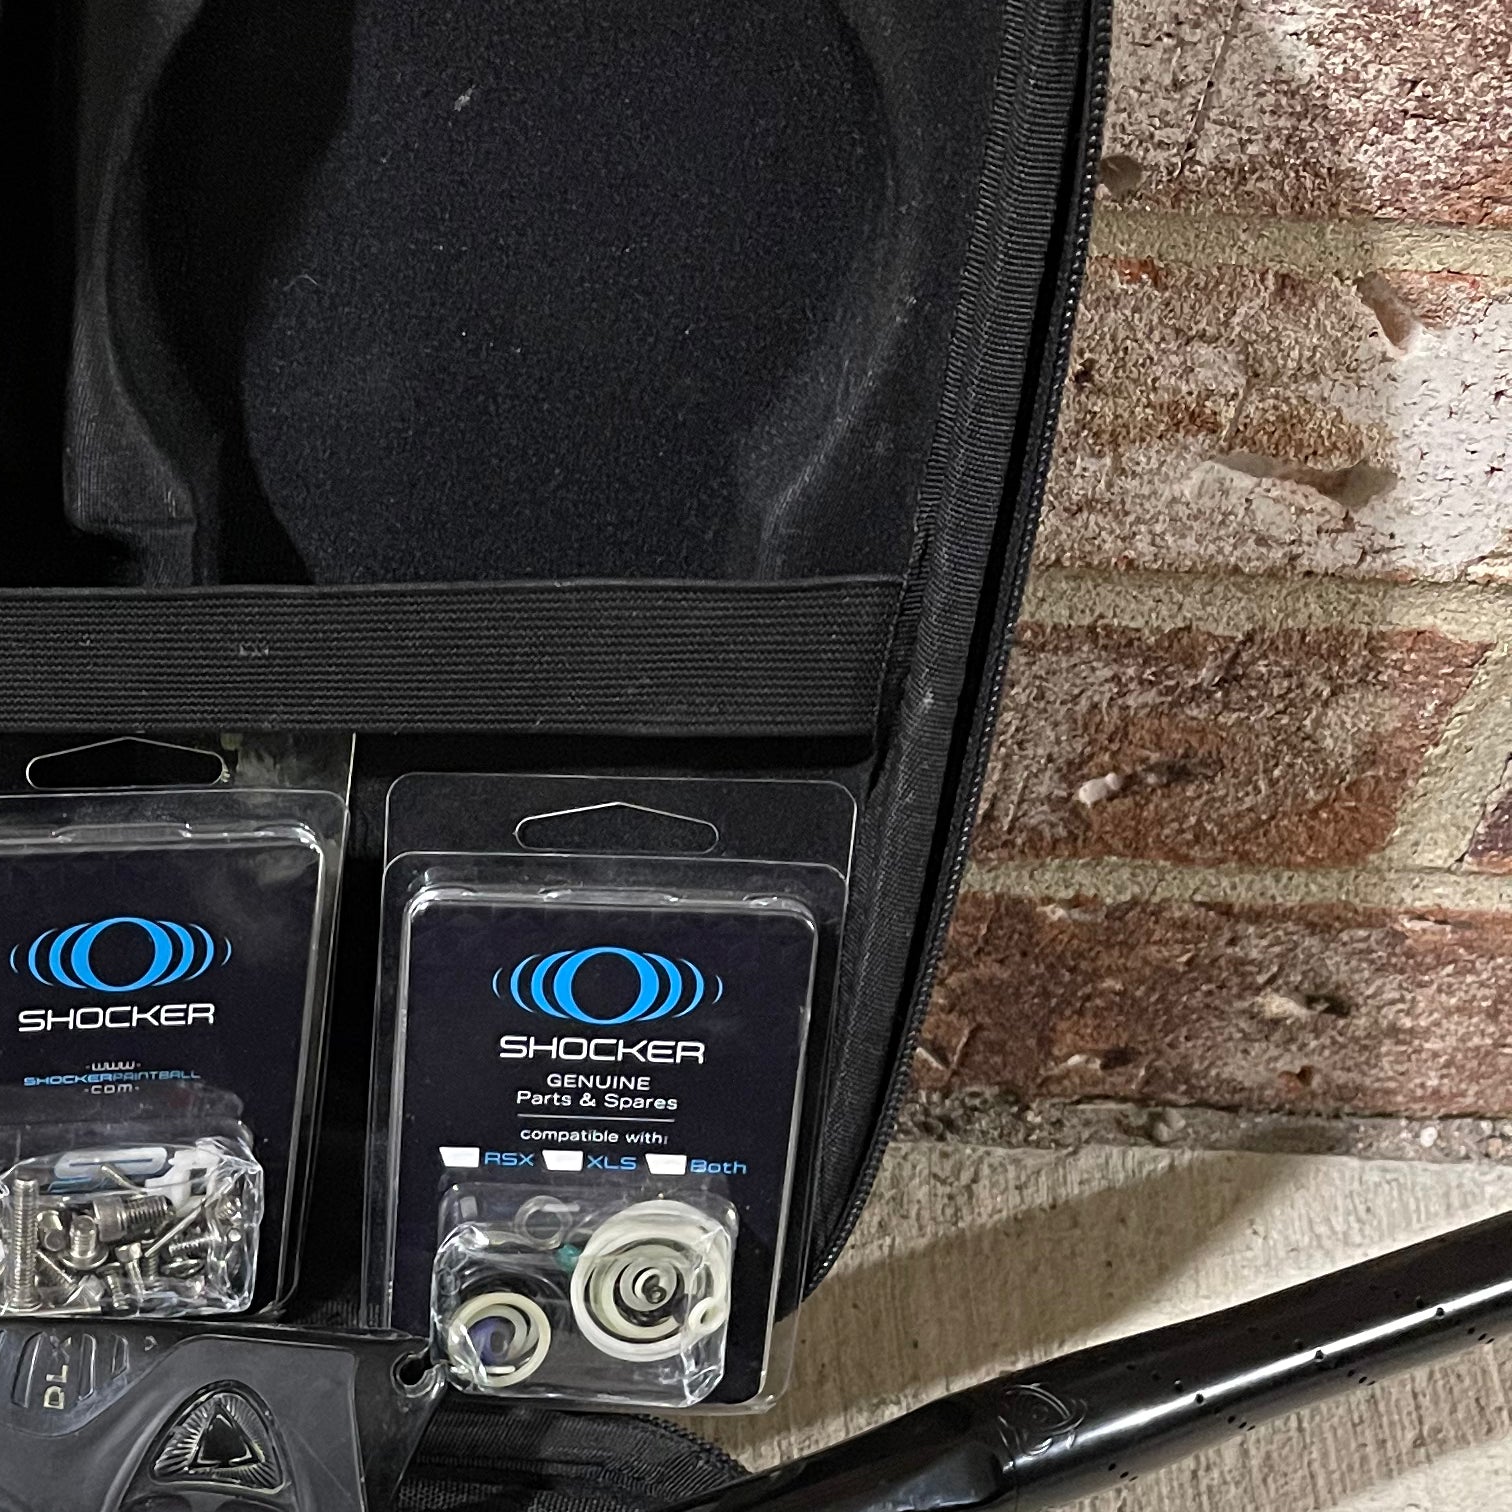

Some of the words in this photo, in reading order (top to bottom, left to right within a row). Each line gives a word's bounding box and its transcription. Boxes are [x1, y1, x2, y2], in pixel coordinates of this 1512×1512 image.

[18, 1003, 215, 1032] SHOCKER
[499, 1035, 706, 1065] SHOCKER
[23, 1070, 201, 1087] SHOCKERPAINTBALL
[546, 1073, 651, 1091] GENUINE
[516, 1091, 572, 1107] Parts
[579, 1093, 597, 1108] &
[604, 1093, 678, 1111] Spares
[520, 1128, 619, 1145] compatible
[484, 1152, 535, 1167] RSX
[587, 1155, 637, 1170] XLS
[690, 1159, 747, 1176] Both
[43, 1334, 72, 1410] DLX
